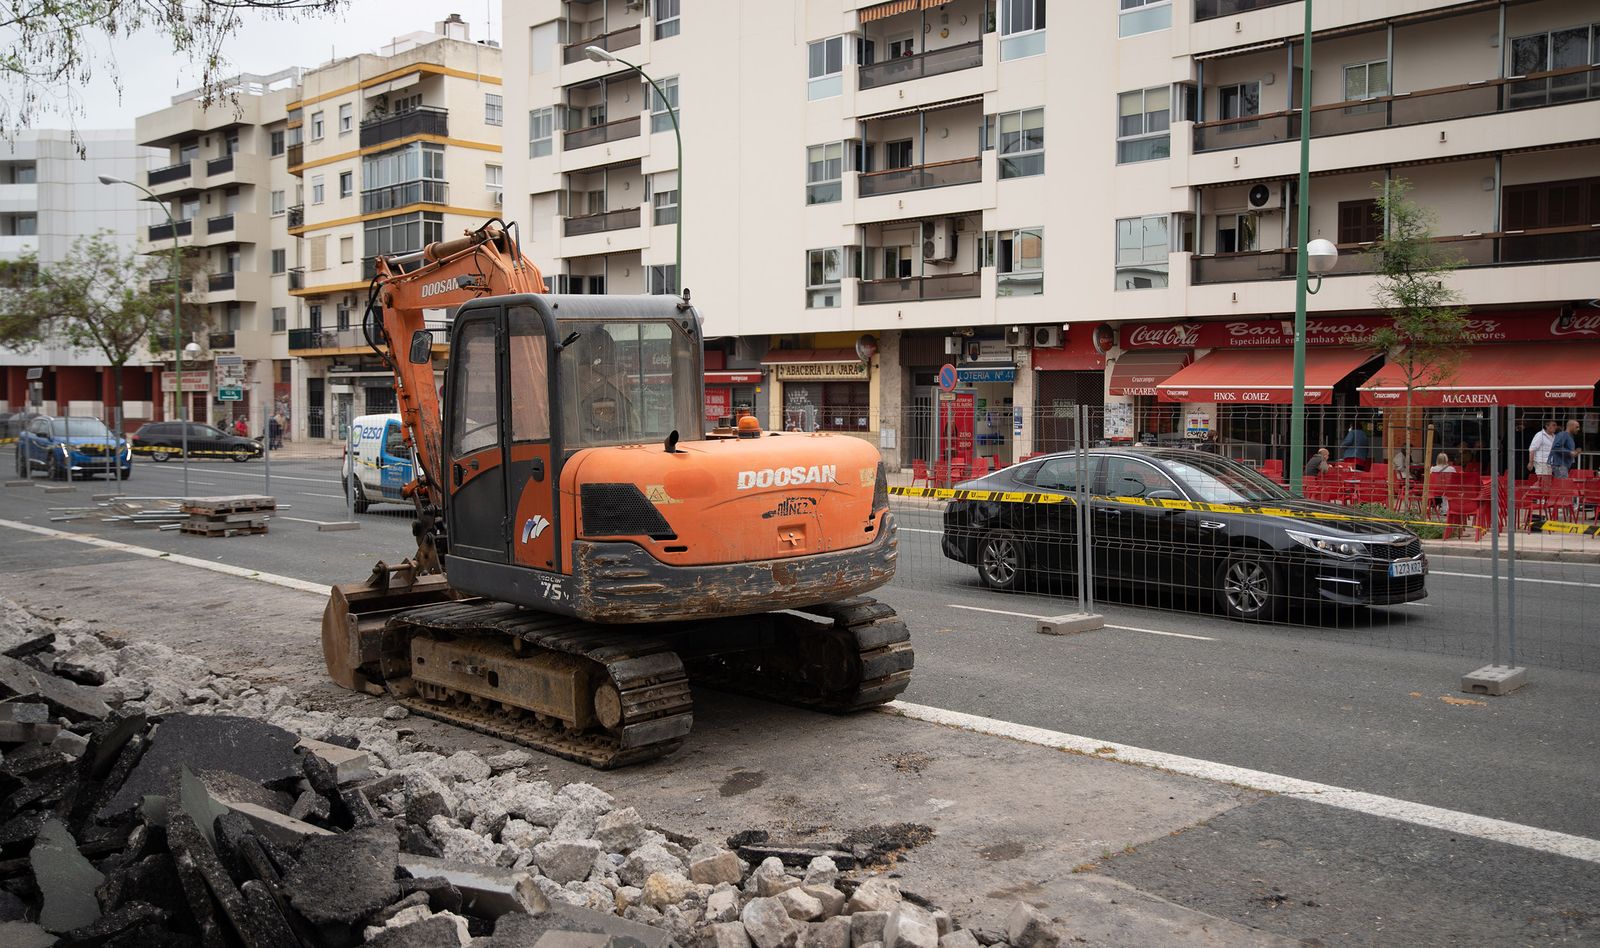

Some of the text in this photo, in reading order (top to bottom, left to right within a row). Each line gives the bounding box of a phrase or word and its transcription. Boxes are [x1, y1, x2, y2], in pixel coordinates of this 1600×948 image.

[421, 277, 459, 298] DOOSAN
[1225, 322, 1279, 336] Bar
[1230, 336, 1281, 346] Especialidad
[1305, 336, 1334, 344] ambas
[1459, 331, 1506, 342] Mayores
[826, 365, 835, 375] LA
[959, 371, 990, 380] LOTERIA
[1122, 387, 1158, 396] MACAREN
[1213, 391, 1270, 401] HNOS. GOMEZ
[1544, 390, 1577, 399] Cruzcampo
[1442, 393, 1498, 403] MACARENA
[362, 426, 383, 440] ezsa
[736, 464, 837, 490] DOOSAN
[540, 581, 562, 600] 75
